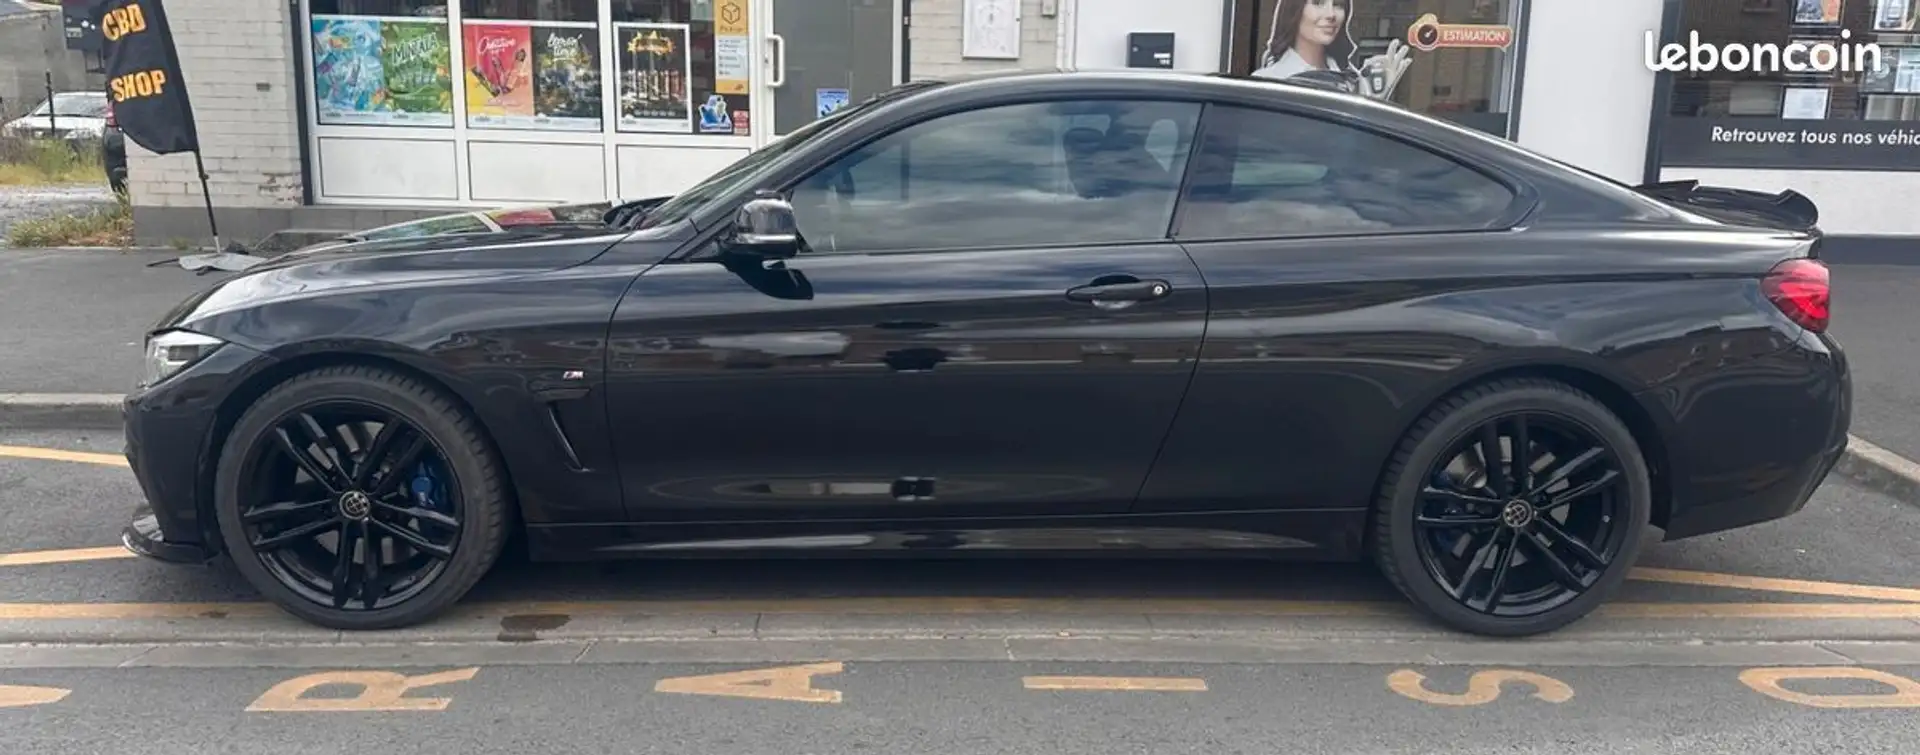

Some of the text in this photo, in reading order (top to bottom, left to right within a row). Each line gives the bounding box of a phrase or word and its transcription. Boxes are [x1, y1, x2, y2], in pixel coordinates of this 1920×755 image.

[103, 4, 146, 41] CBD
[1442, 29, 1507, 43] ESTIMATION
[111, 69, 167, 103] SHOP
[1711, 126, 1795, 143] Retrouvez
[1801, 129, 1836, 144] tous
[1842, 133, 1872, 145] nos
